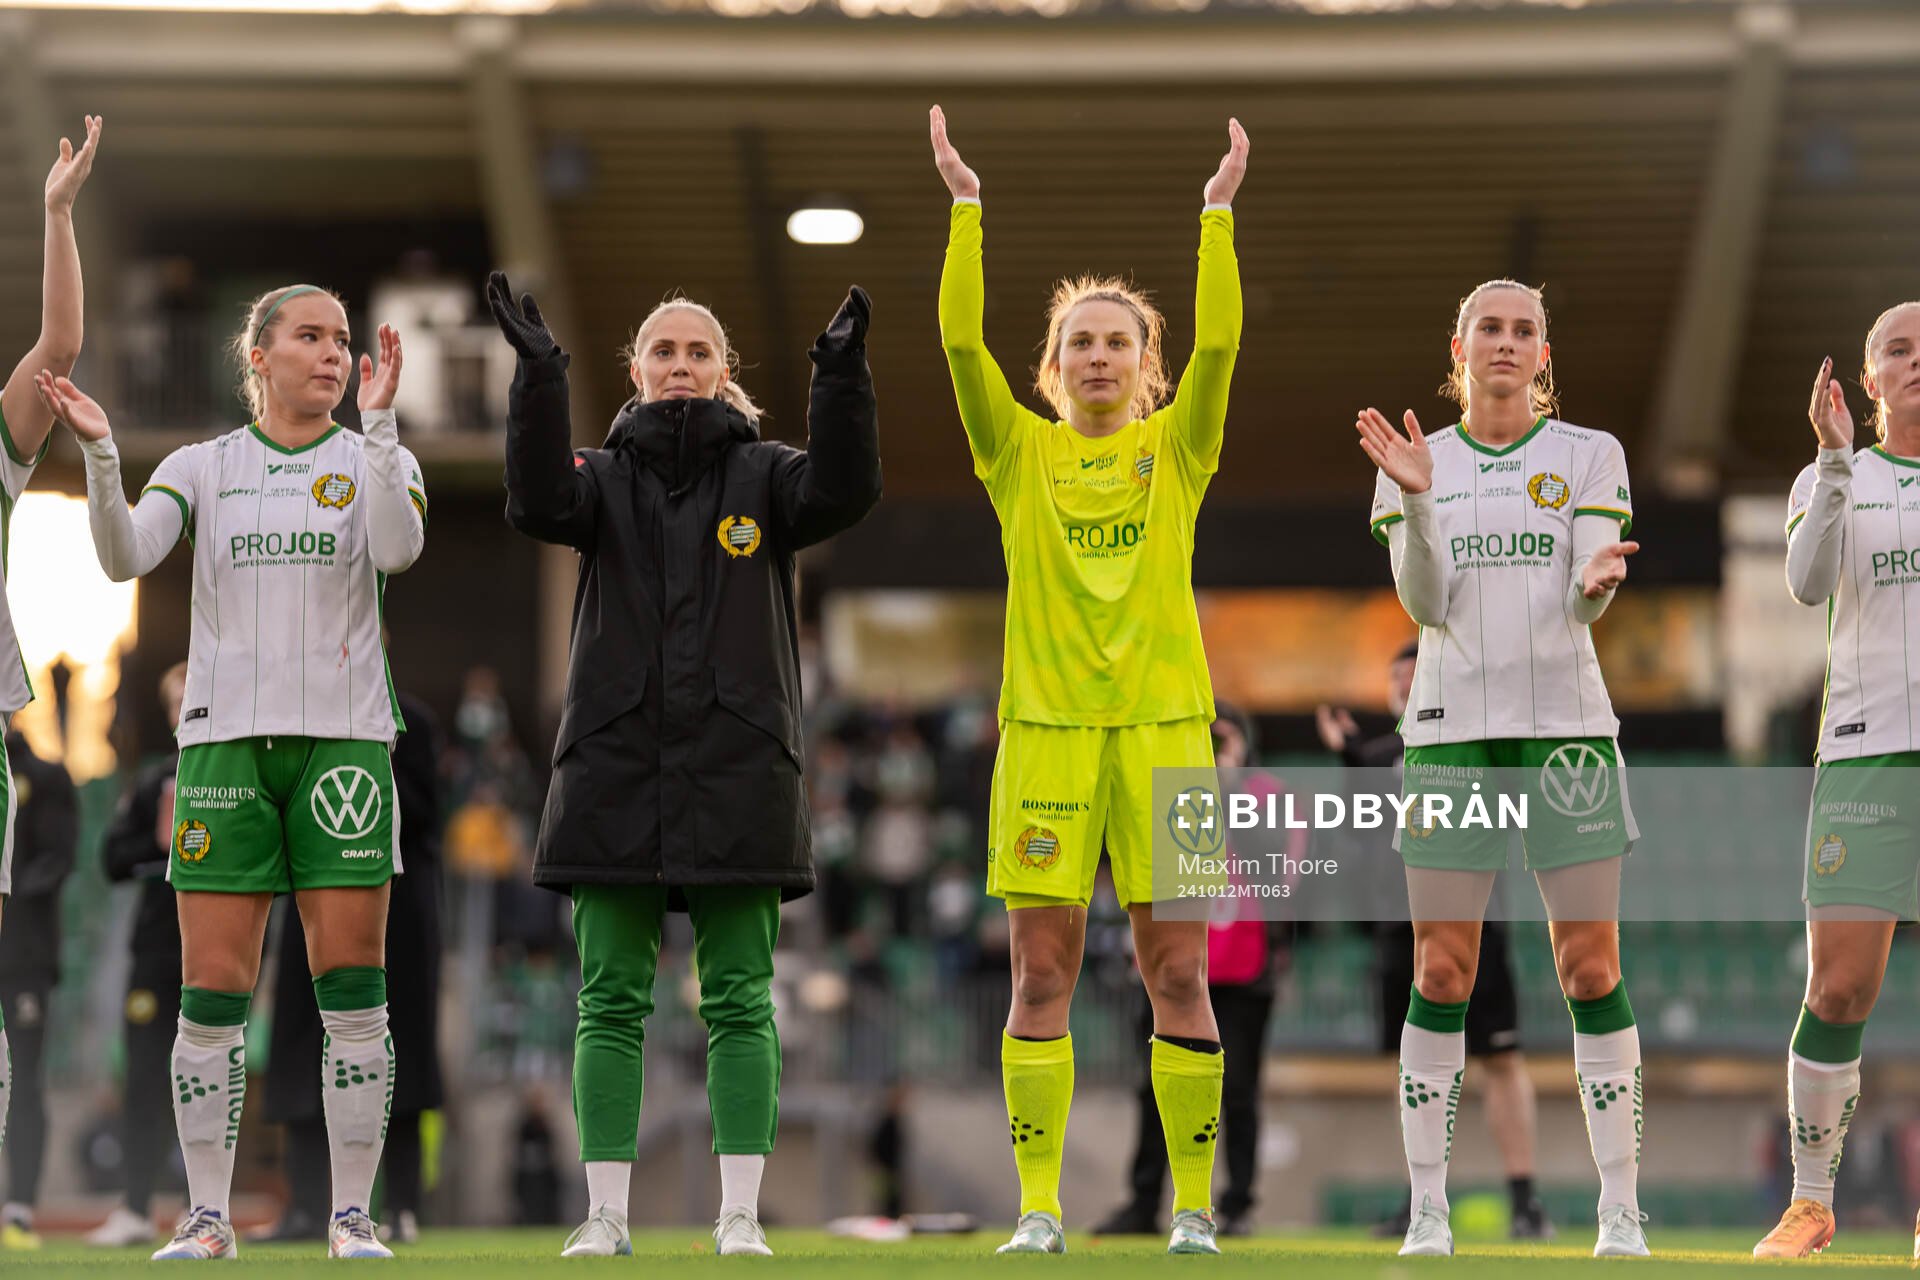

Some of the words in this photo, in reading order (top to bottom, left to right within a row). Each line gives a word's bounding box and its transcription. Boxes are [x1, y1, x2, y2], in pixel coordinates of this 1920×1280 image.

[1435, 491, 1461, 504] RAFT
[1064, 521, 1145, 549] ROJO
[231, 532, 336, 560] PROJOB
[1450, 532, 1555, 562] PROJOB
[233, 559, 287, 571] PROFESSIONAL
[289, 558, 335, 567] WORKWEAR
[1455, 560, 1508, 572] PROFESSIONAL
[1510, 559, 1551, 568] WORKWEAR
[1410, 763, 1483, 780] BOSPHORUS
[180, 786, 256, 800] BOSPHORUS
[1820, 802, 1897, 817] BOSPHORUS
[1577, 821, 1609, 833] CRAFT
[341, 849, 377, 859] CRAFT
